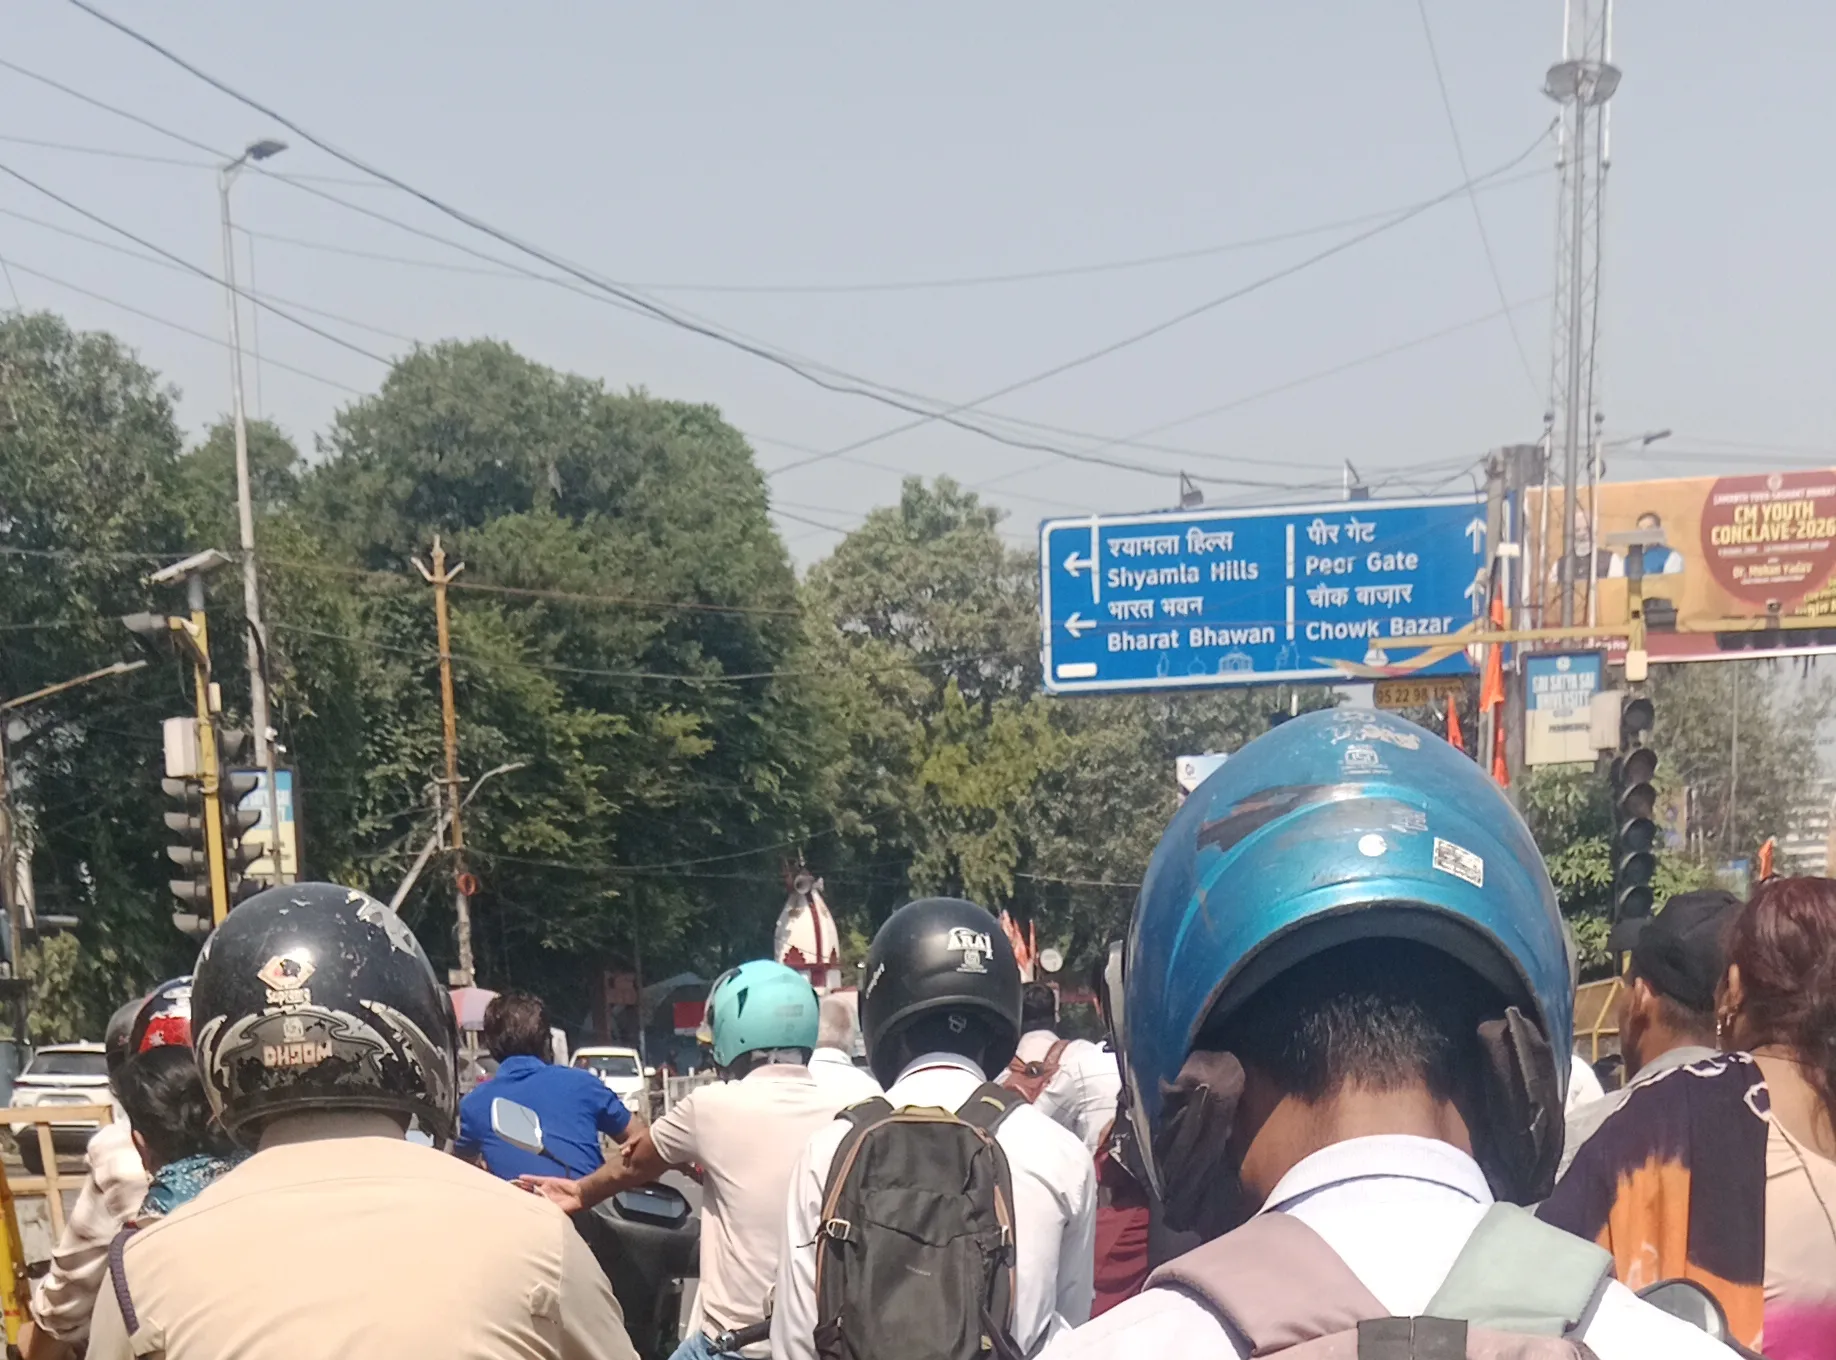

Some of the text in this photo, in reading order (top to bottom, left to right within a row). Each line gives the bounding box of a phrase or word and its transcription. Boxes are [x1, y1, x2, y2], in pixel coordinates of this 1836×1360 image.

[1734, 500, 1815, 524] CM YOUTH
[1107, 526, 1234, 557] श्यामला हिल्स
[1306, 516, 1376, 545] पीर गेट
[1366, 551, 1419, 572] Gate
[1107, 560, 1259, 591] Shyamla Hills
[1108, 596, 1204, 620] भारत भवन
[1306, 582, 1349, 608] चौक
[1107, 626, 1275, 652] Bharat Bhawan
[1306, 616, 1454, 641] Chowk Bazar
[947, 931, 993, 960] ARAI
